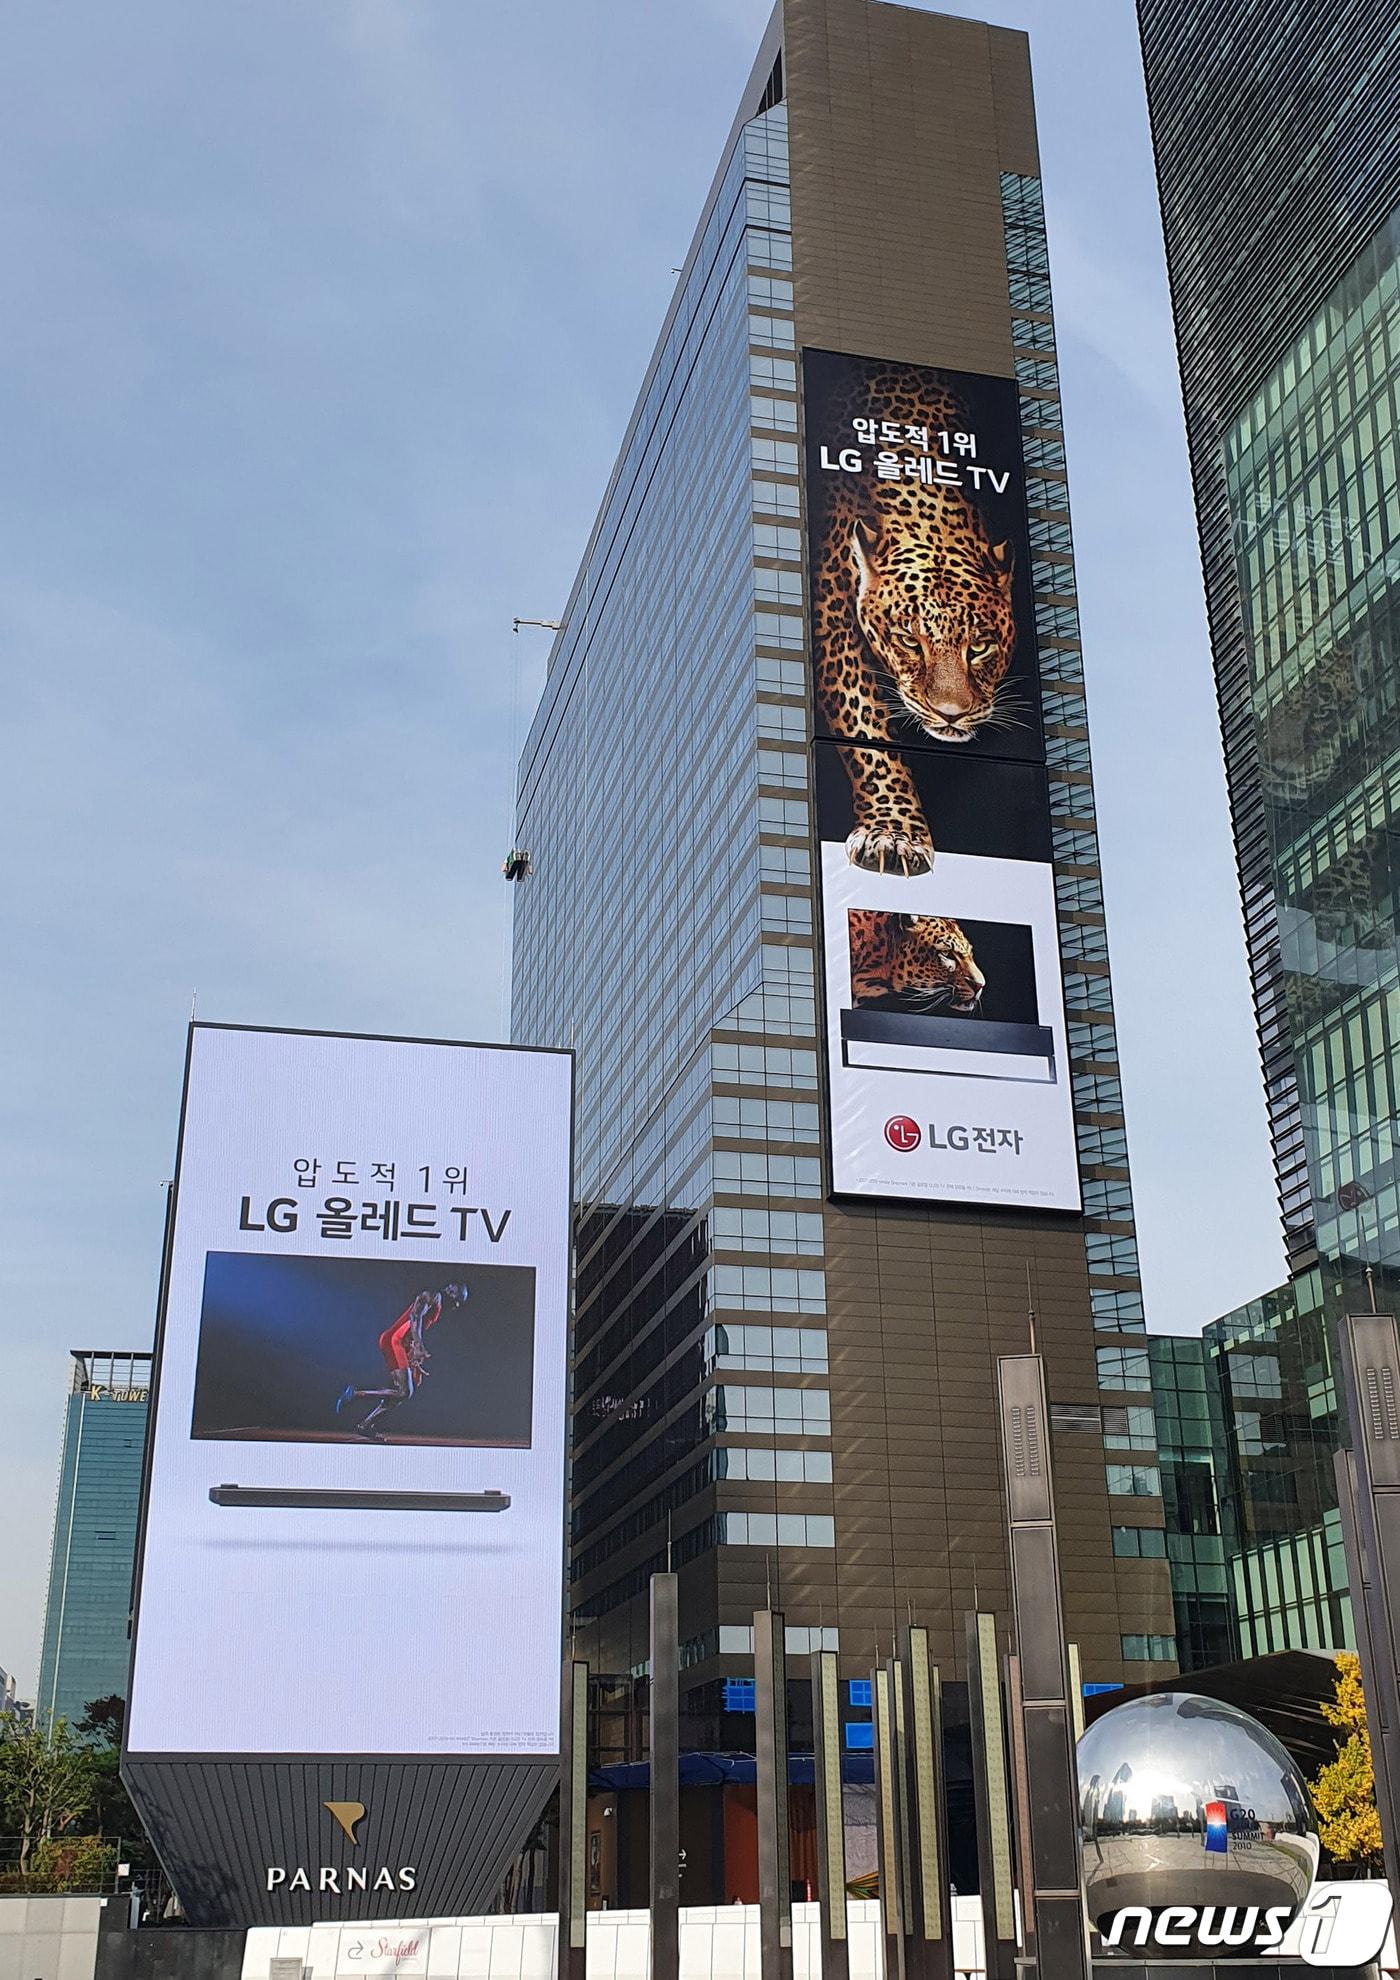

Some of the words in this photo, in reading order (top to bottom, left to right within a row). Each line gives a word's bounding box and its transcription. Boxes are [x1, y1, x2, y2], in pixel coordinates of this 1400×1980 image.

[852, 417, 928, 452] 압도적
[937, 431, 977, 459] 1위
[819, 445, 863, 473] LG
[873, 450, 963, 487] 올레드
[965, 464, 1010, 494] TV
[929, 1123, 1024, 1155] LG전자
[293, 1158, 396, 1193] 압도적
[418, 1165, 468, 1196] 1위
[239, 1196, 298, 1233] LG
[316, 1197, 442, 1241] 올레드
[450, 1207, 512, 1243] TV
[1230, 1808, 1256, 1821] G20
[1232, 1831, 1265, 1841] SUMMIT
[1232, 1842, 1252, 1850] 2010
[267, 1867, 416, 1894] PARNAS
[371, 1937, 419, 1967] Starfield
